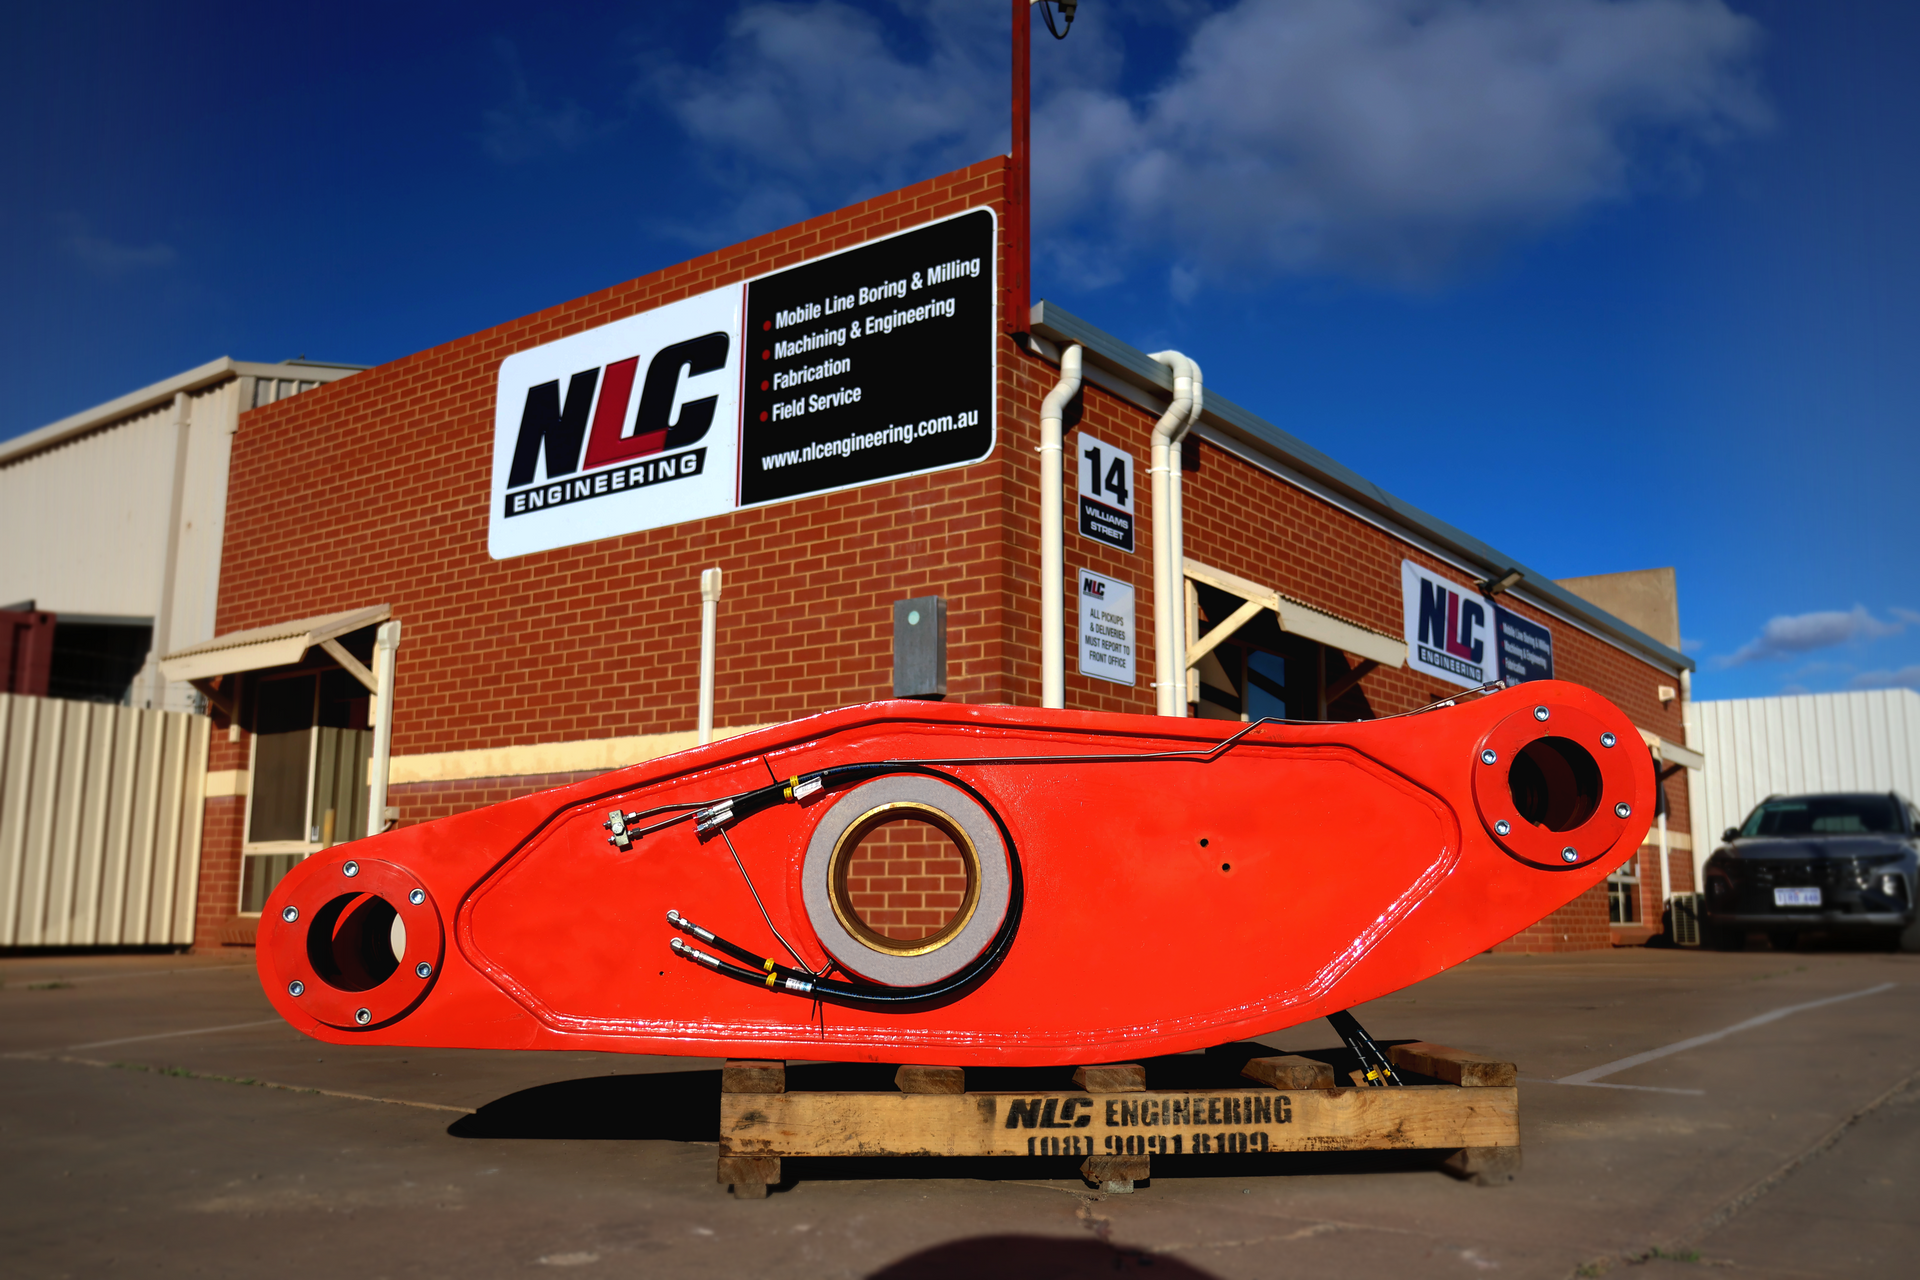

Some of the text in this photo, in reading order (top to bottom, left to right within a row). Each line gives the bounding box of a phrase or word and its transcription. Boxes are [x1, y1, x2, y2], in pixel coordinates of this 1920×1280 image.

[775, 258, 981, 329] Mobile Line Boring & Milling
[774, 297, 955, 360] Machining & Engineering
[773, 357, 851, 391] Fabrication
[507, 331, 730, 490] NLC
[772, 387, 861, 422] Field Service
[762, 409, 979, 471] www.nlcengineering.com.au
[513, 453, 698, 513] ENGINEERING
[1084, 446, 1128, 507] 14
[1085, 505, 1129, 530] WILLIAMS
[1090, 521, 1124, 540] STREET
[1083, 577, 1105, 597] NLC
[1090, 608, 1124, 627] ALL PICKUPS
[1090, 622, 1125, 641] & DELIVERIES
[1418, 577, 1484, 664] NLC
[1085, 635, 1130, 656] MUST REPORT TO
[1089, 650, 1126, 668] FRONT OFFICE
[1421, 649, 1482, 679] ENGINEERING
[1005, 1095, 1292, 1129] NLC ENGINEERING
